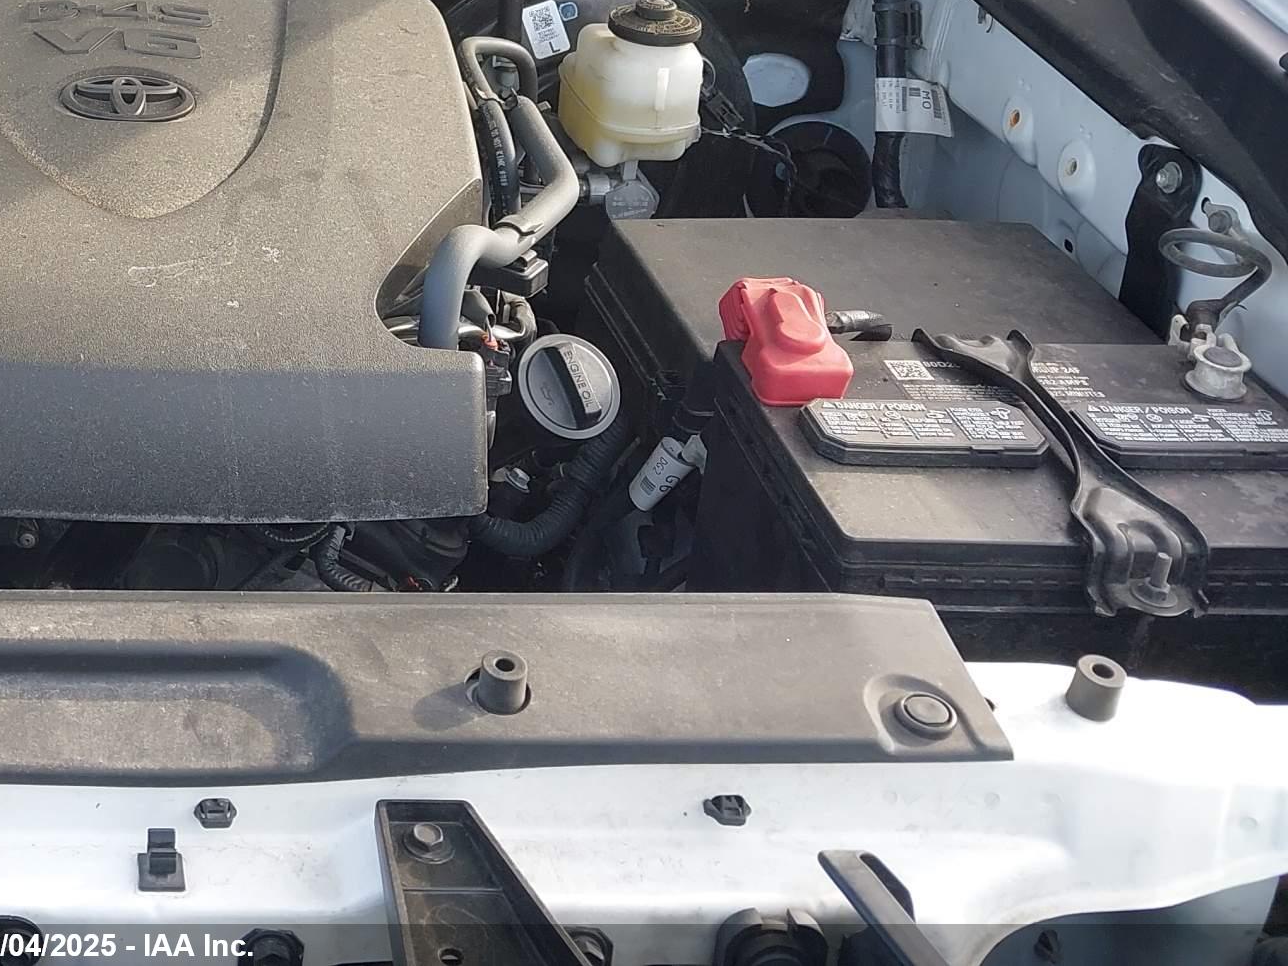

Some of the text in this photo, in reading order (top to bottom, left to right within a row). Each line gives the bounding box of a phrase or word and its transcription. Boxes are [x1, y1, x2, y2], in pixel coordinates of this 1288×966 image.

[32, 26, 202, 59] V6
[549, 41, 561, 53] L
[563, 350, 594, 408] ENGINE OIL
[834, 402, 878, 410] DANGER
[885, 402, 927, 412] POISON
[1098, 404, 1144, 414] DANGER
[1150, 406, 1192, 414] POISON
